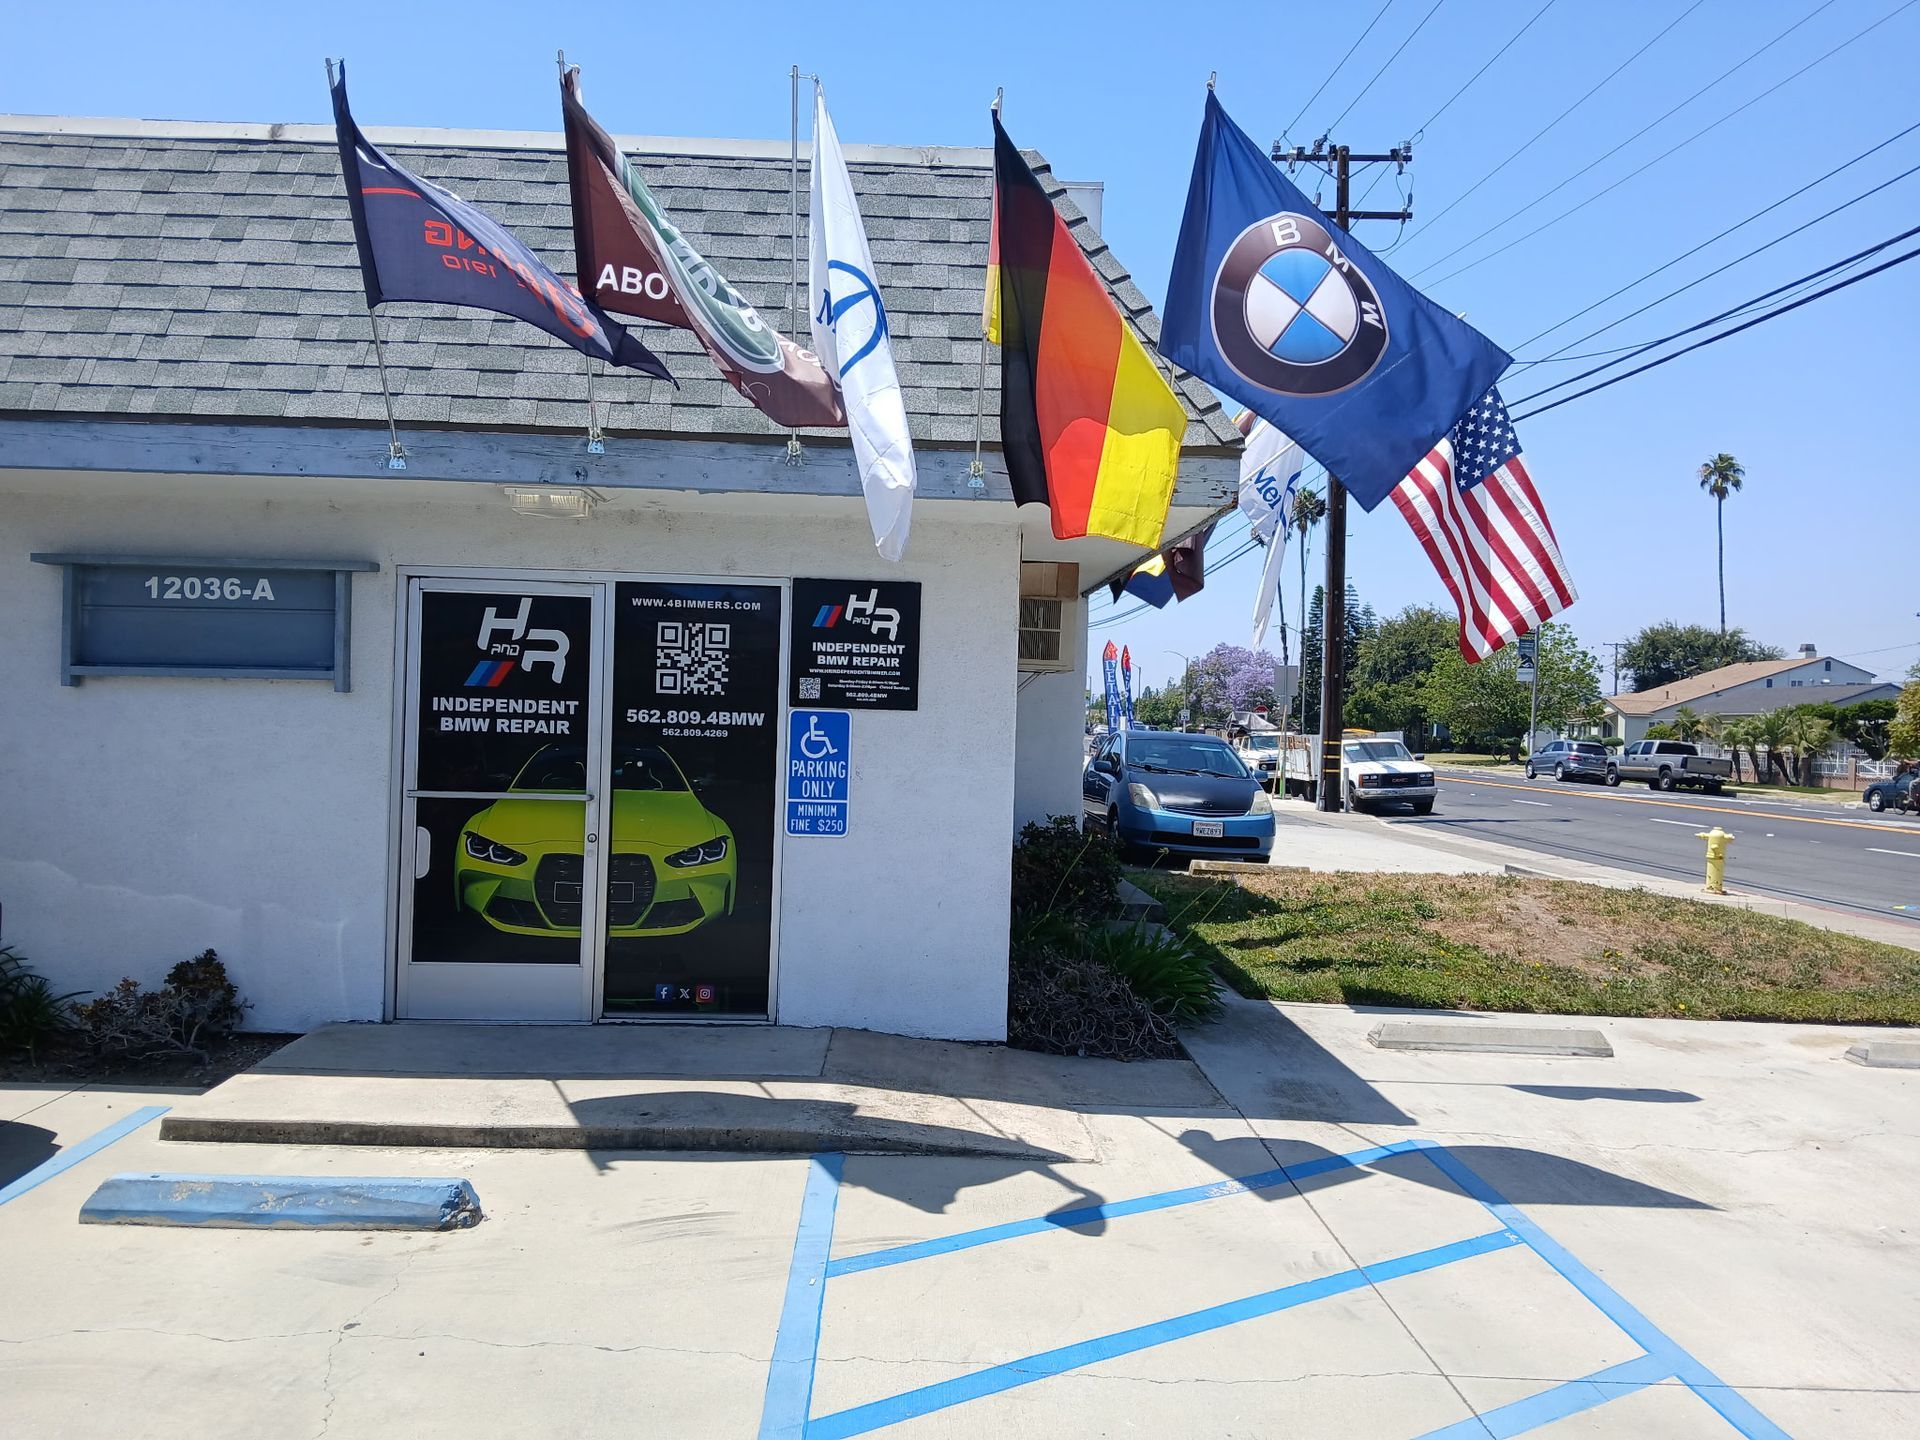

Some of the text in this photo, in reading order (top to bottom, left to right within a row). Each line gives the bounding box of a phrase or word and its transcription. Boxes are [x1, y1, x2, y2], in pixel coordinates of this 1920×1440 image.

[1271, 218, 1384, 330] BMW
[596, 263, 680, 306] ABO
[144, 576, 275, 601] 12036-A
[631, 597, 761, 611] WWW.4BIMMERS.COM
[812, 641, 906, 655] INDEPENDENT
[817, 655, 900, 668] BMW REPAIR
[432, 696, 580, 715] INDEPENDENT
[440, 717, 570, 735] BMW REPAIR
[626, 709, 766, 727] 562.809.4BMW
[662, 728, 729, 738] 562.809.4269
[791, 760, 846, 779] PARKING
[801, 780, 835, 798] ONLY
[797, 804, 837, 817] MINIMUM
[790, 818, 844, 832] FINE $250
